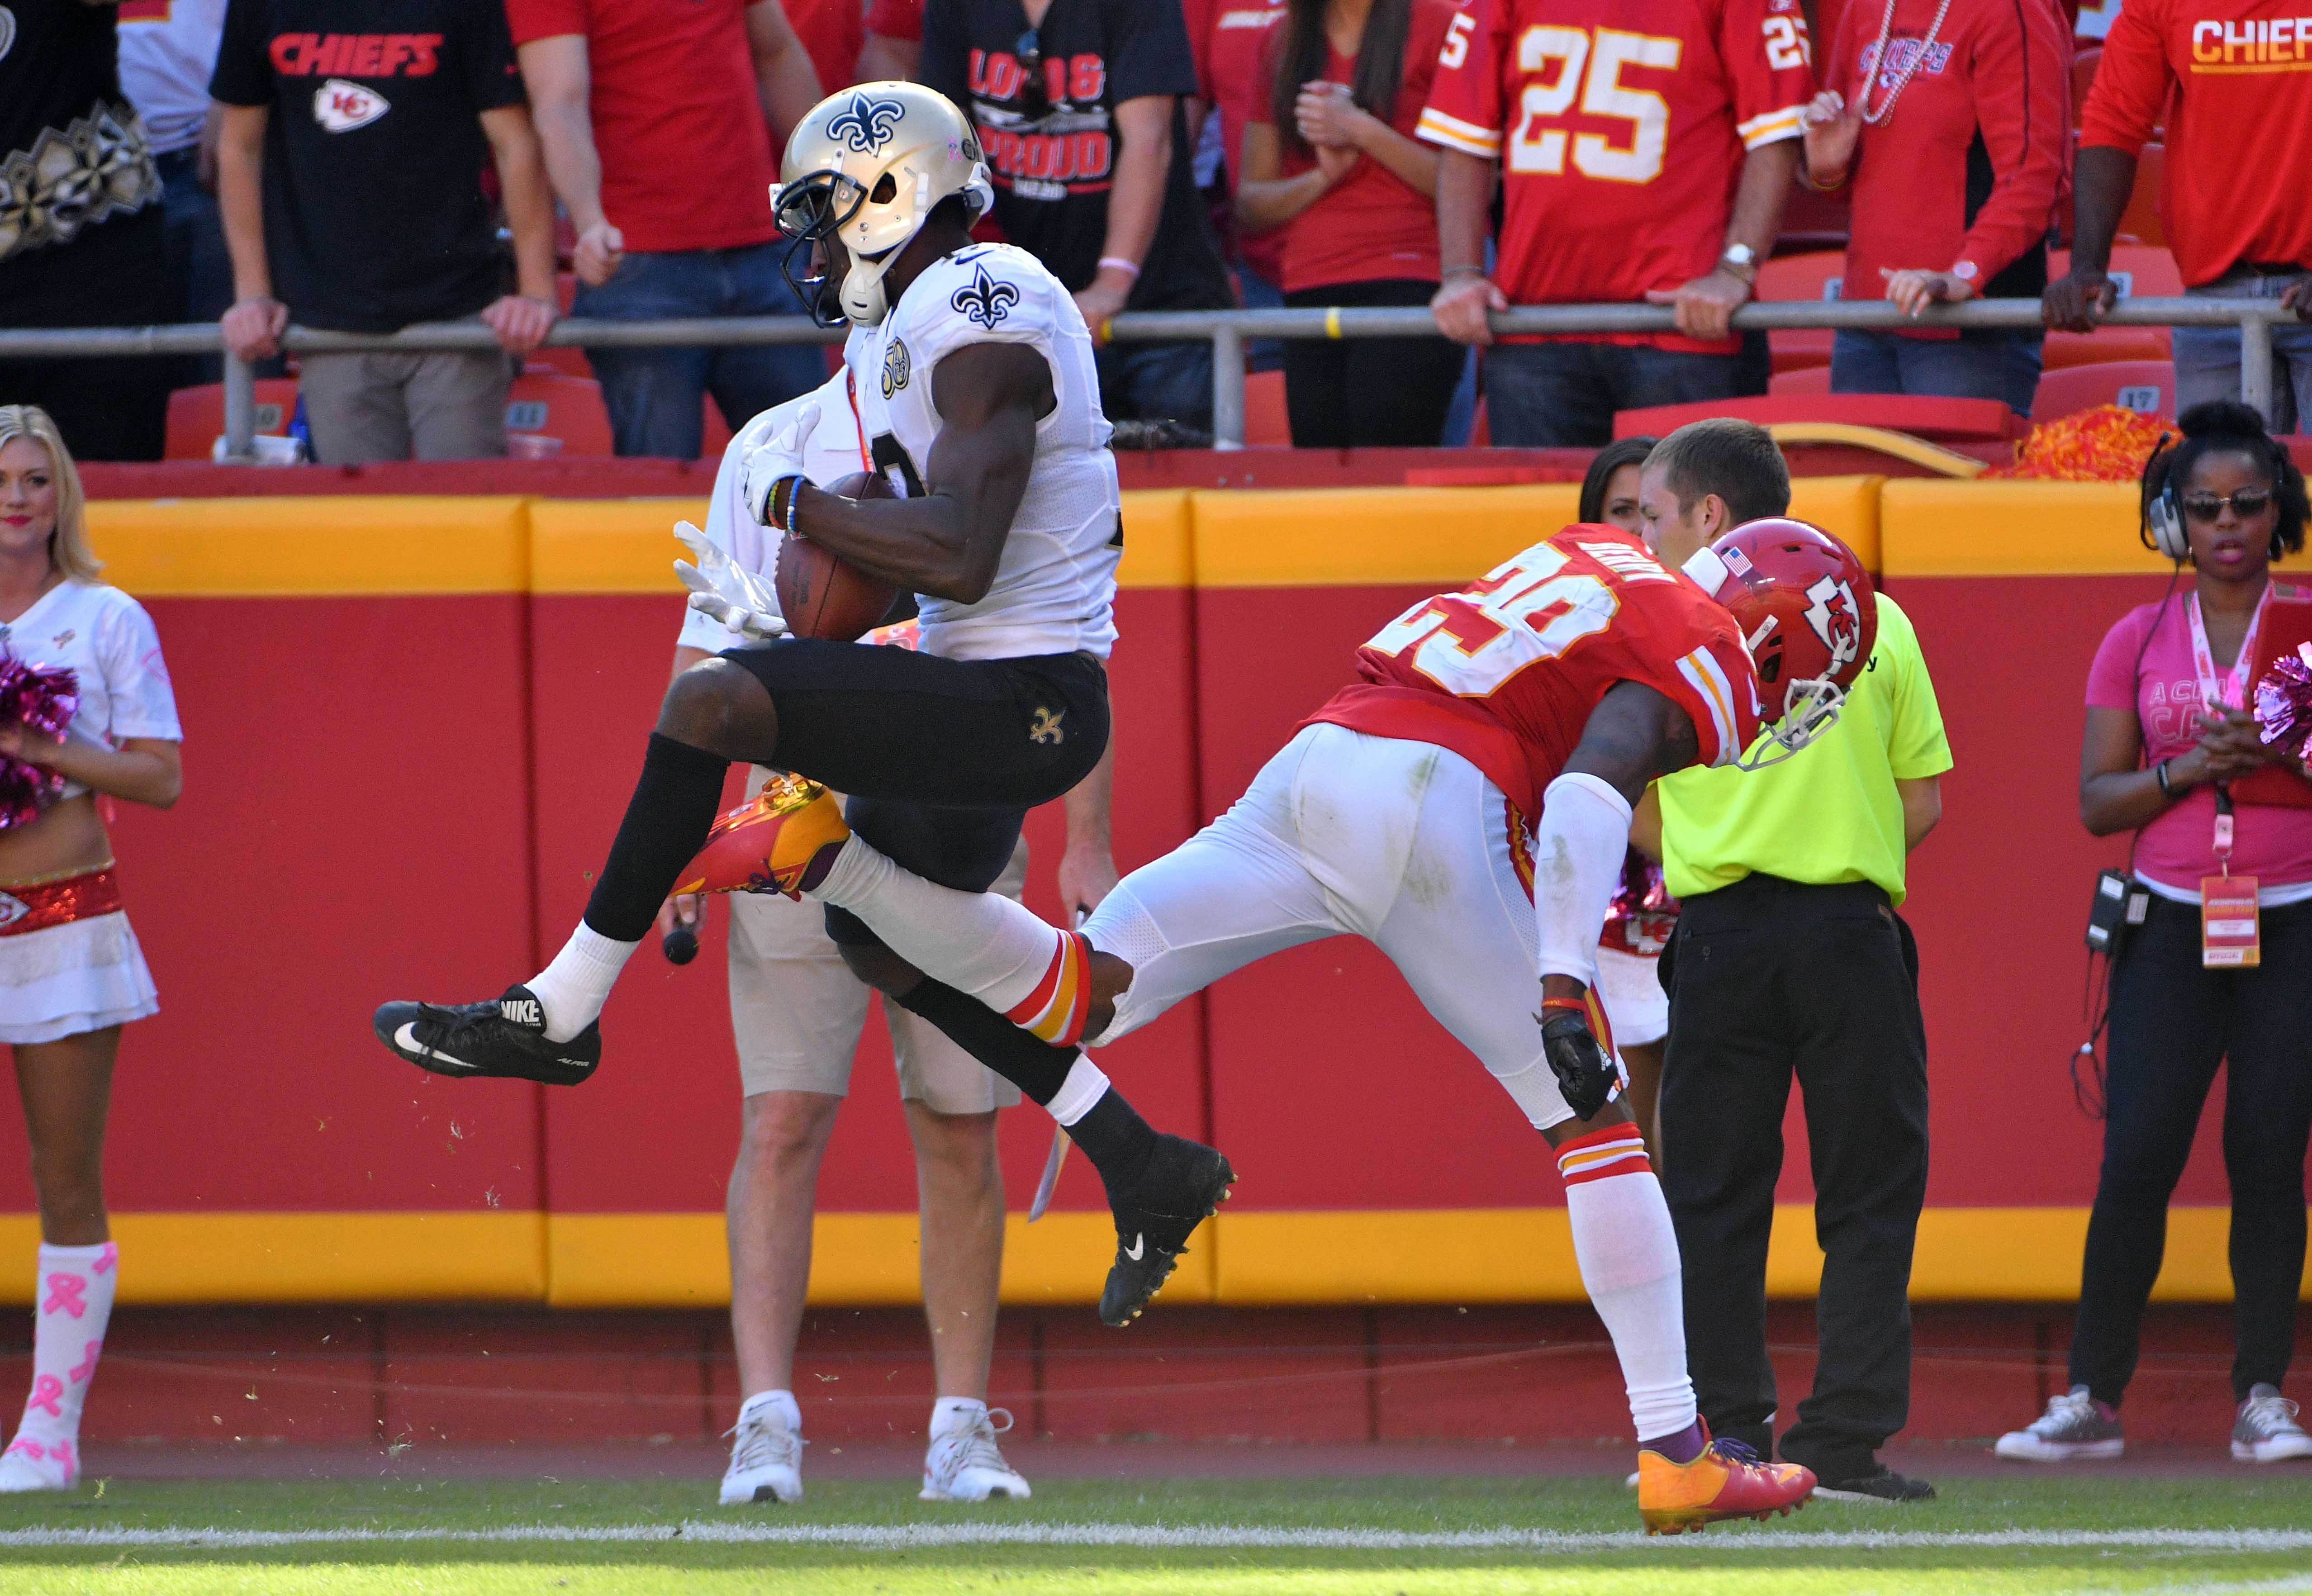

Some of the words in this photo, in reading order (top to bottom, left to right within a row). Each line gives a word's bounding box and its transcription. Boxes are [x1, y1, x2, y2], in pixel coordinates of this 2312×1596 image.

[269, 32, 445, 77] CHIEFS
[1510, 24, 1683, 185] 25
[976, 124, 1112, 181] PROUD
[1357, 540, 1622, 699] 29
[501, 999, 540, 1023] NIKE
